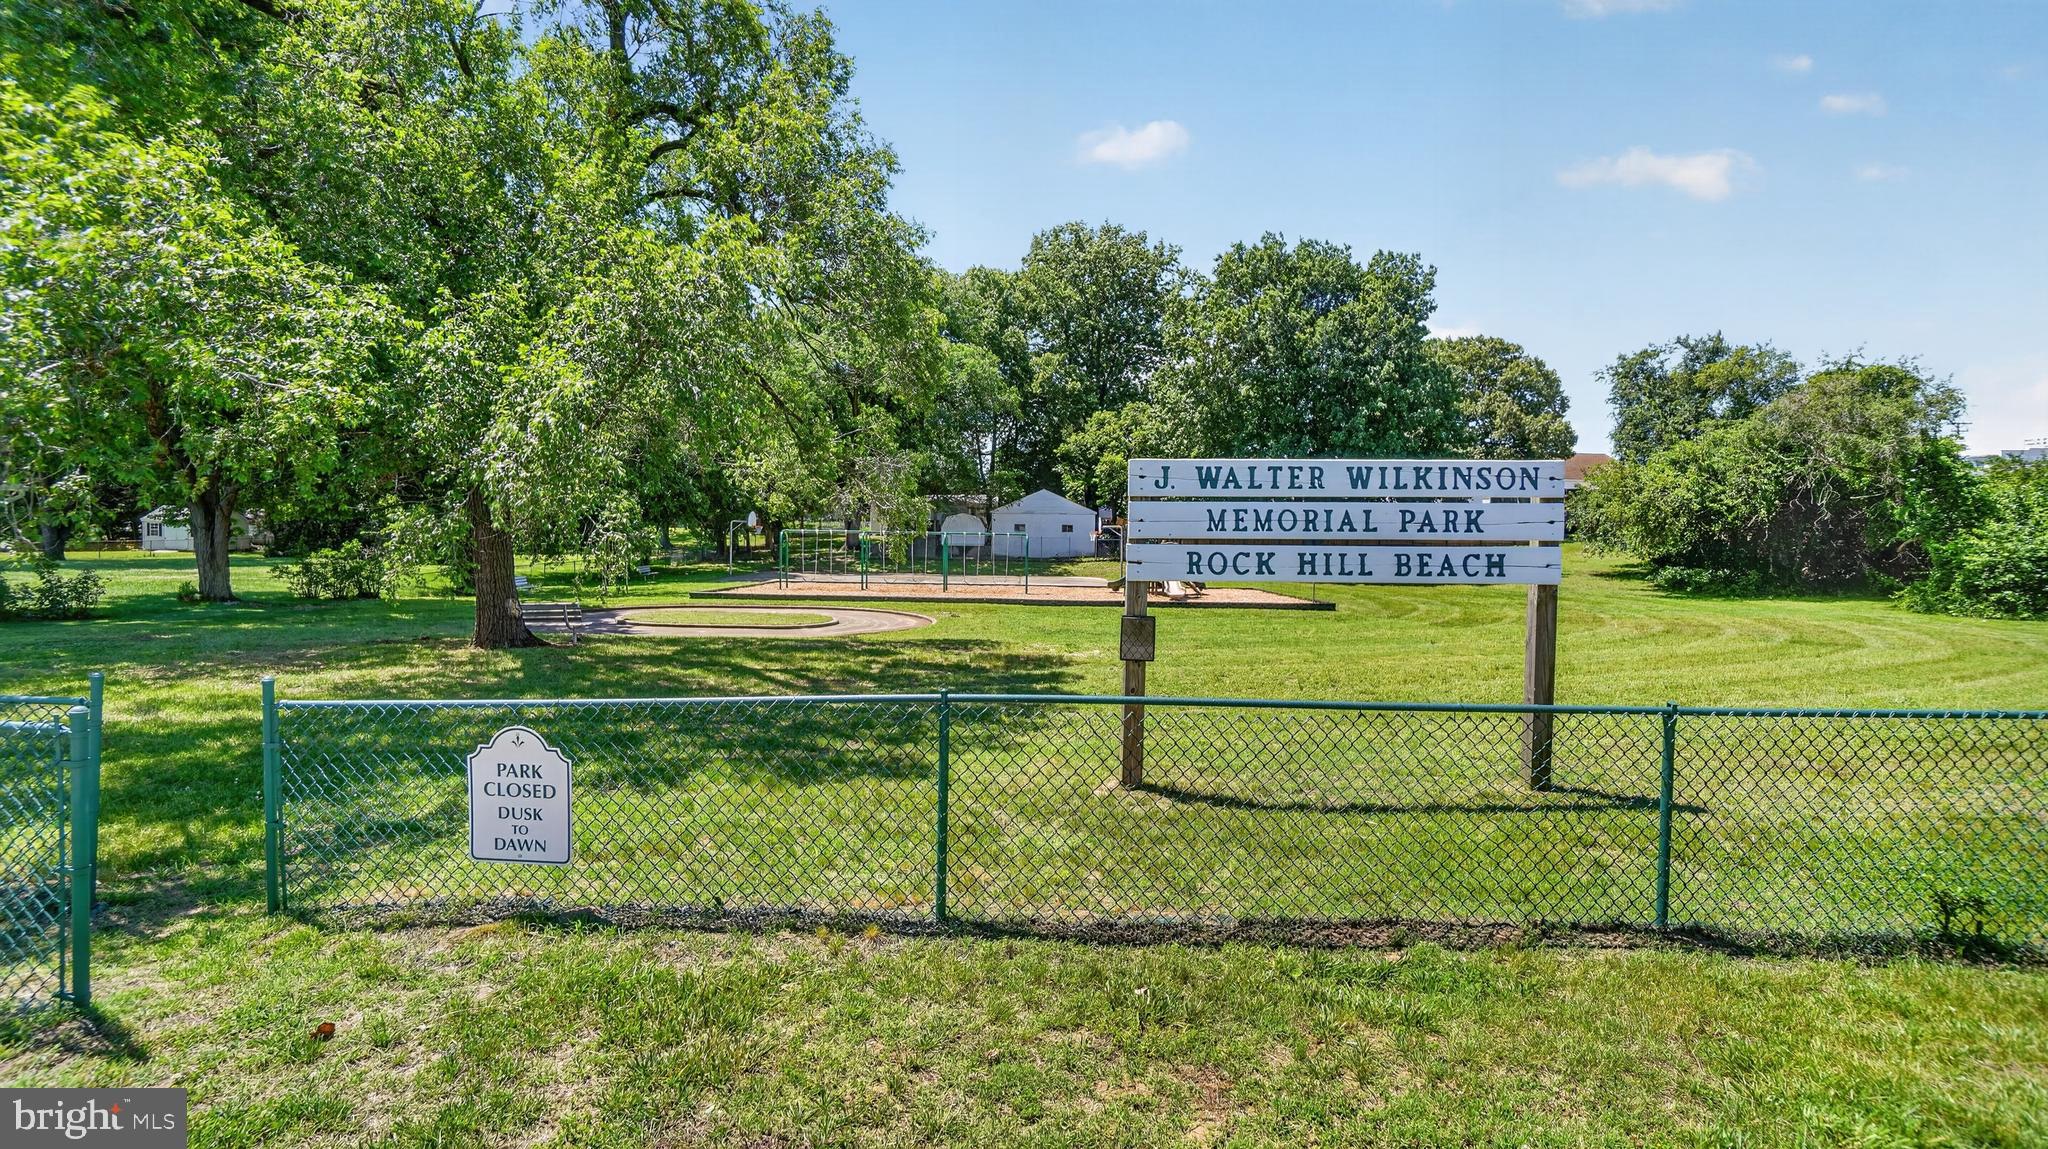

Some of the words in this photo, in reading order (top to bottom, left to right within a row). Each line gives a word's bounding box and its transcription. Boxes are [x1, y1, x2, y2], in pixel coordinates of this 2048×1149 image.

[1153, 466, 1176, 490] J.
[1195, 465, 1326, 490] WALTER
[1346, 466, 1541, 491] WILKINSON
[1206, 508, 1378, 533] MEMORIAL
[1398, 509, 1485, 534] PARK
[1186, 551, 1276, 576] ROCK
[1297, 552, 1373, 577] HILL
[1394, 553, 1507, 578] BEACH
[497, 763, 543, 779] PARK
[483, 781, 556, 799] CLOSED
[498, 806, 543, 821] DUSK
[511, 824, 529, 835] TO
[494, 837, 547, 852] DAWN
